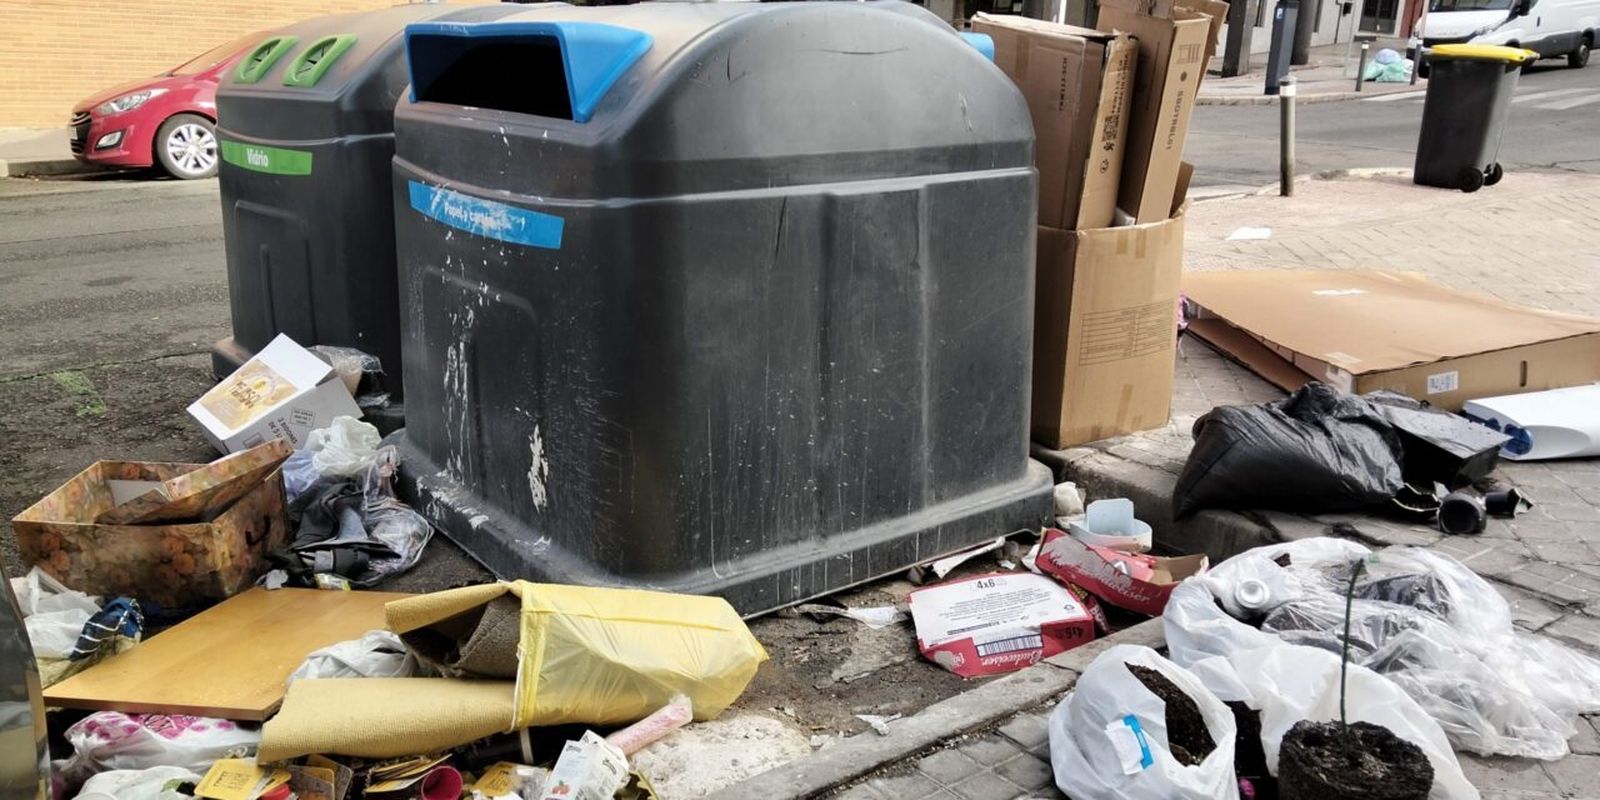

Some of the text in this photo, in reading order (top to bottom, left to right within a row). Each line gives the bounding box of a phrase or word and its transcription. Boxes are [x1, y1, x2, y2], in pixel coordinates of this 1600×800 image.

[246, 148, 269, 168] Vidrio
[976, 578, 996, 589] 4x6
[981, 648, 1043, 667] Budweiser
